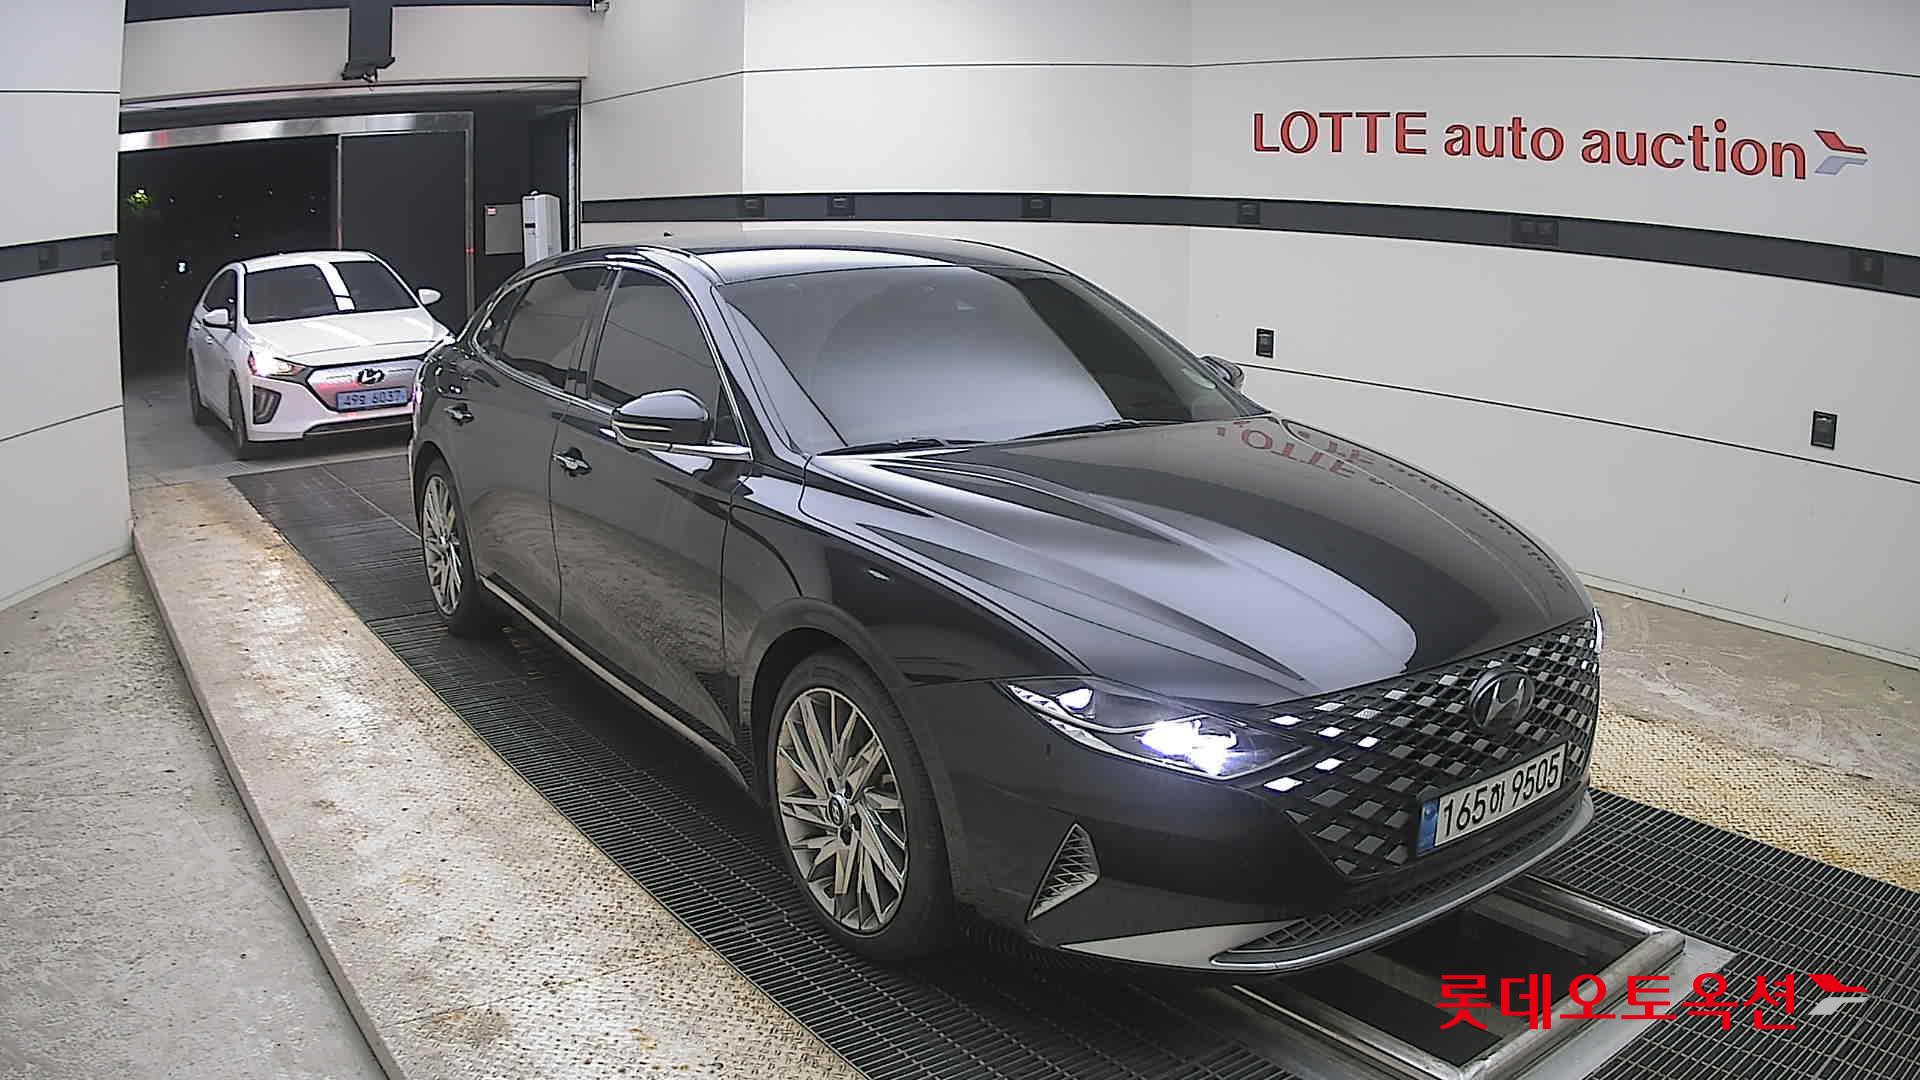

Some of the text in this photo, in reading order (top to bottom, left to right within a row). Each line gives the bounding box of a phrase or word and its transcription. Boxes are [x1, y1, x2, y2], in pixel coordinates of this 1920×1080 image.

[1252, 110, 1807, 181] LOTTE auto auction
[1442, 751, 1562, 838] 165하 9505
